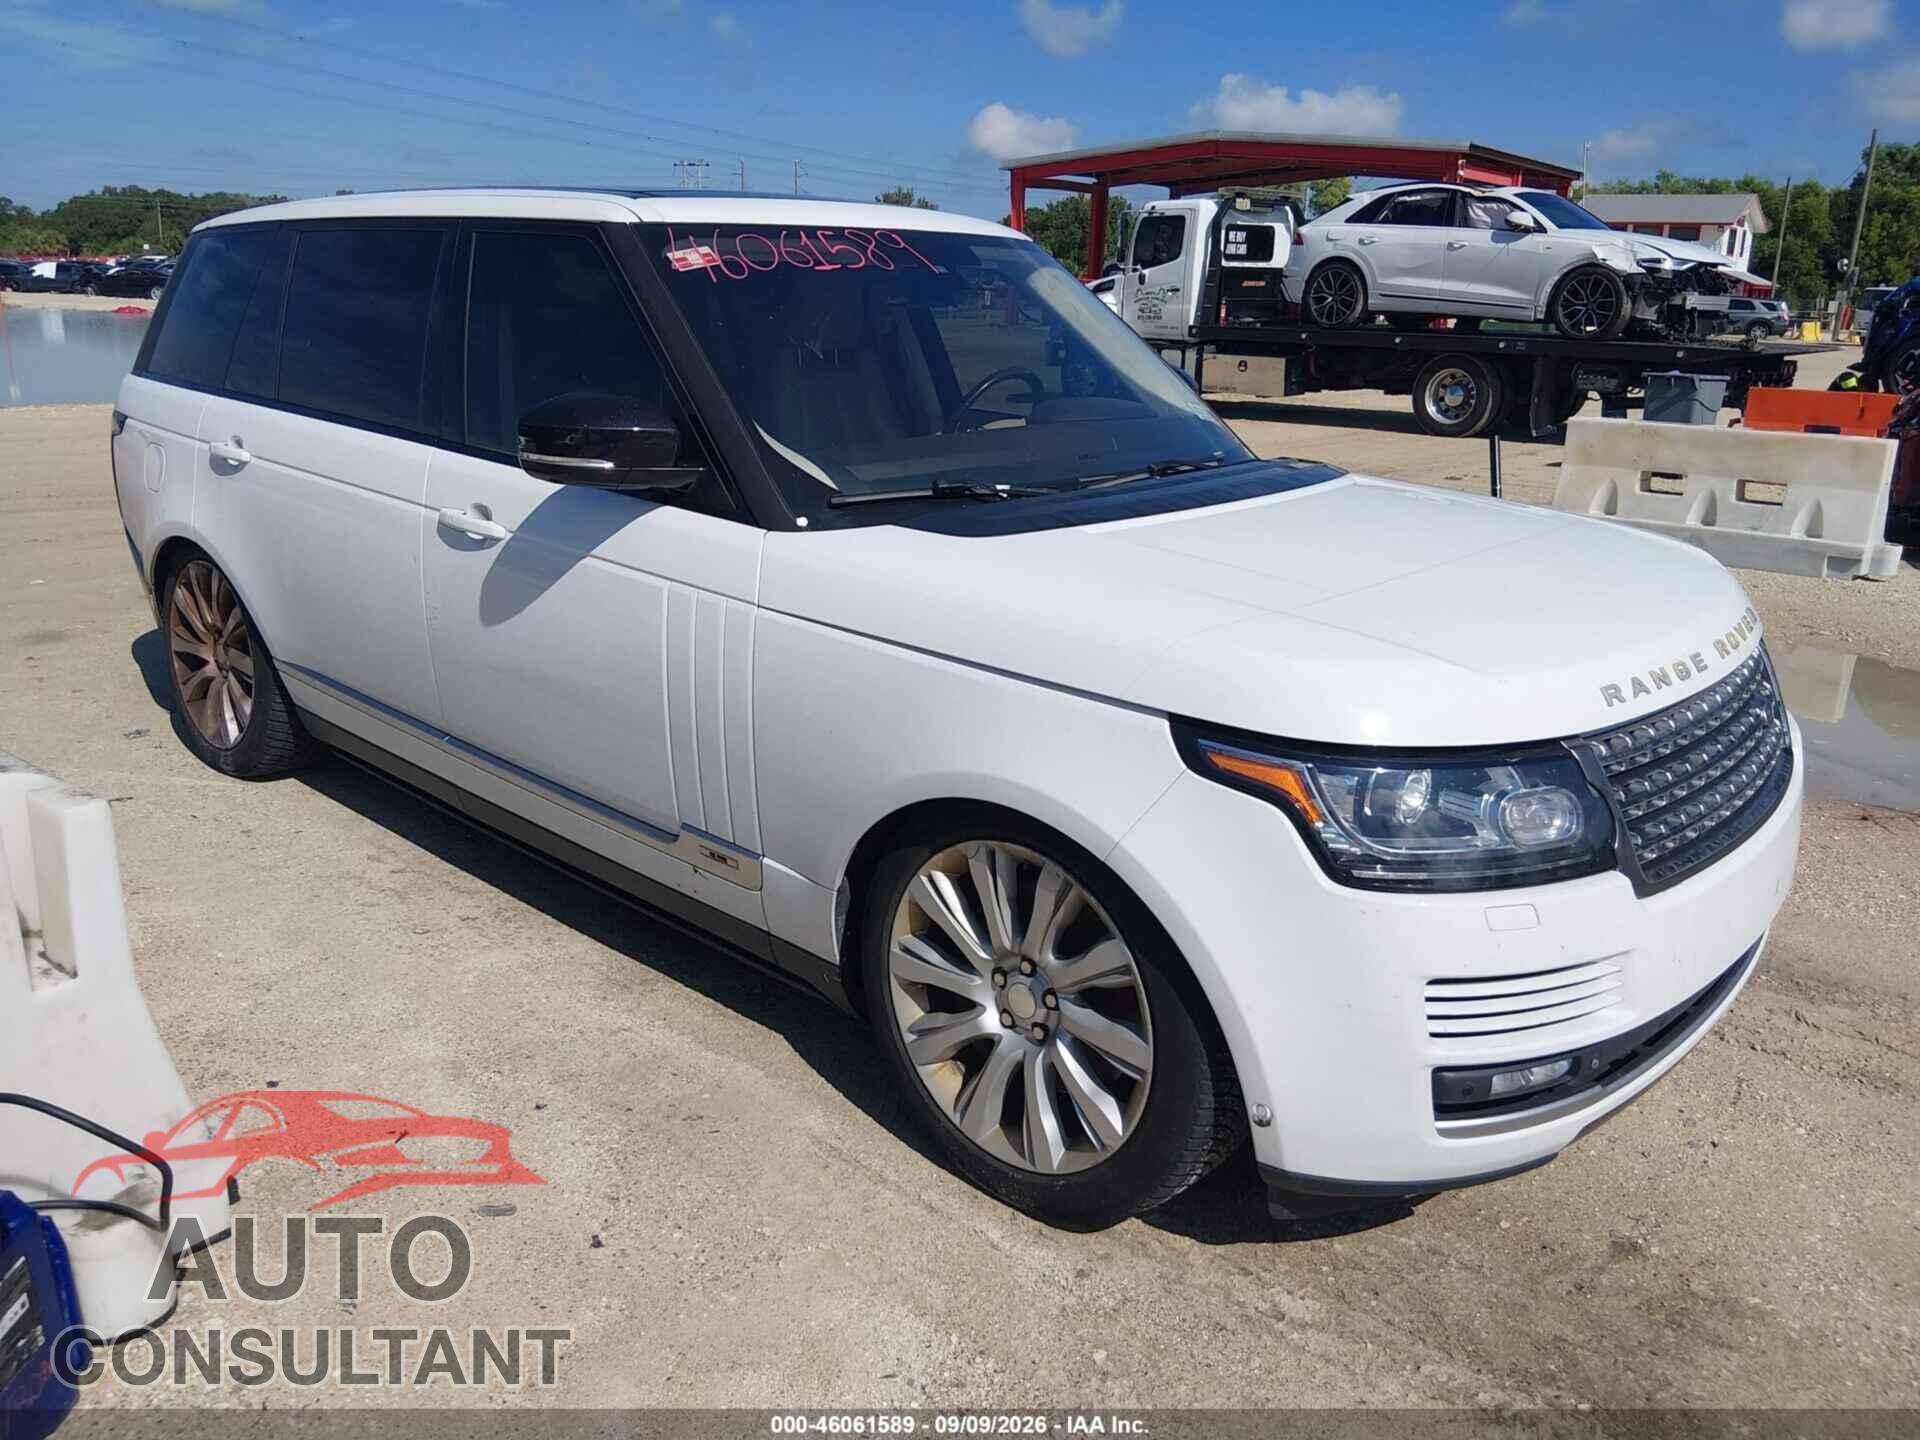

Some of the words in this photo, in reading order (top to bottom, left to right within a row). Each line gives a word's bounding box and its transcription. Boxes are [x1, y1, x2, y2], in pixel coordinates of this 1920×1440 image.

[667, 226, 941, 283] 46061589
[1236, 231, 1247, 243] BUY
[1600, 652, 1708, 707] RANGE
